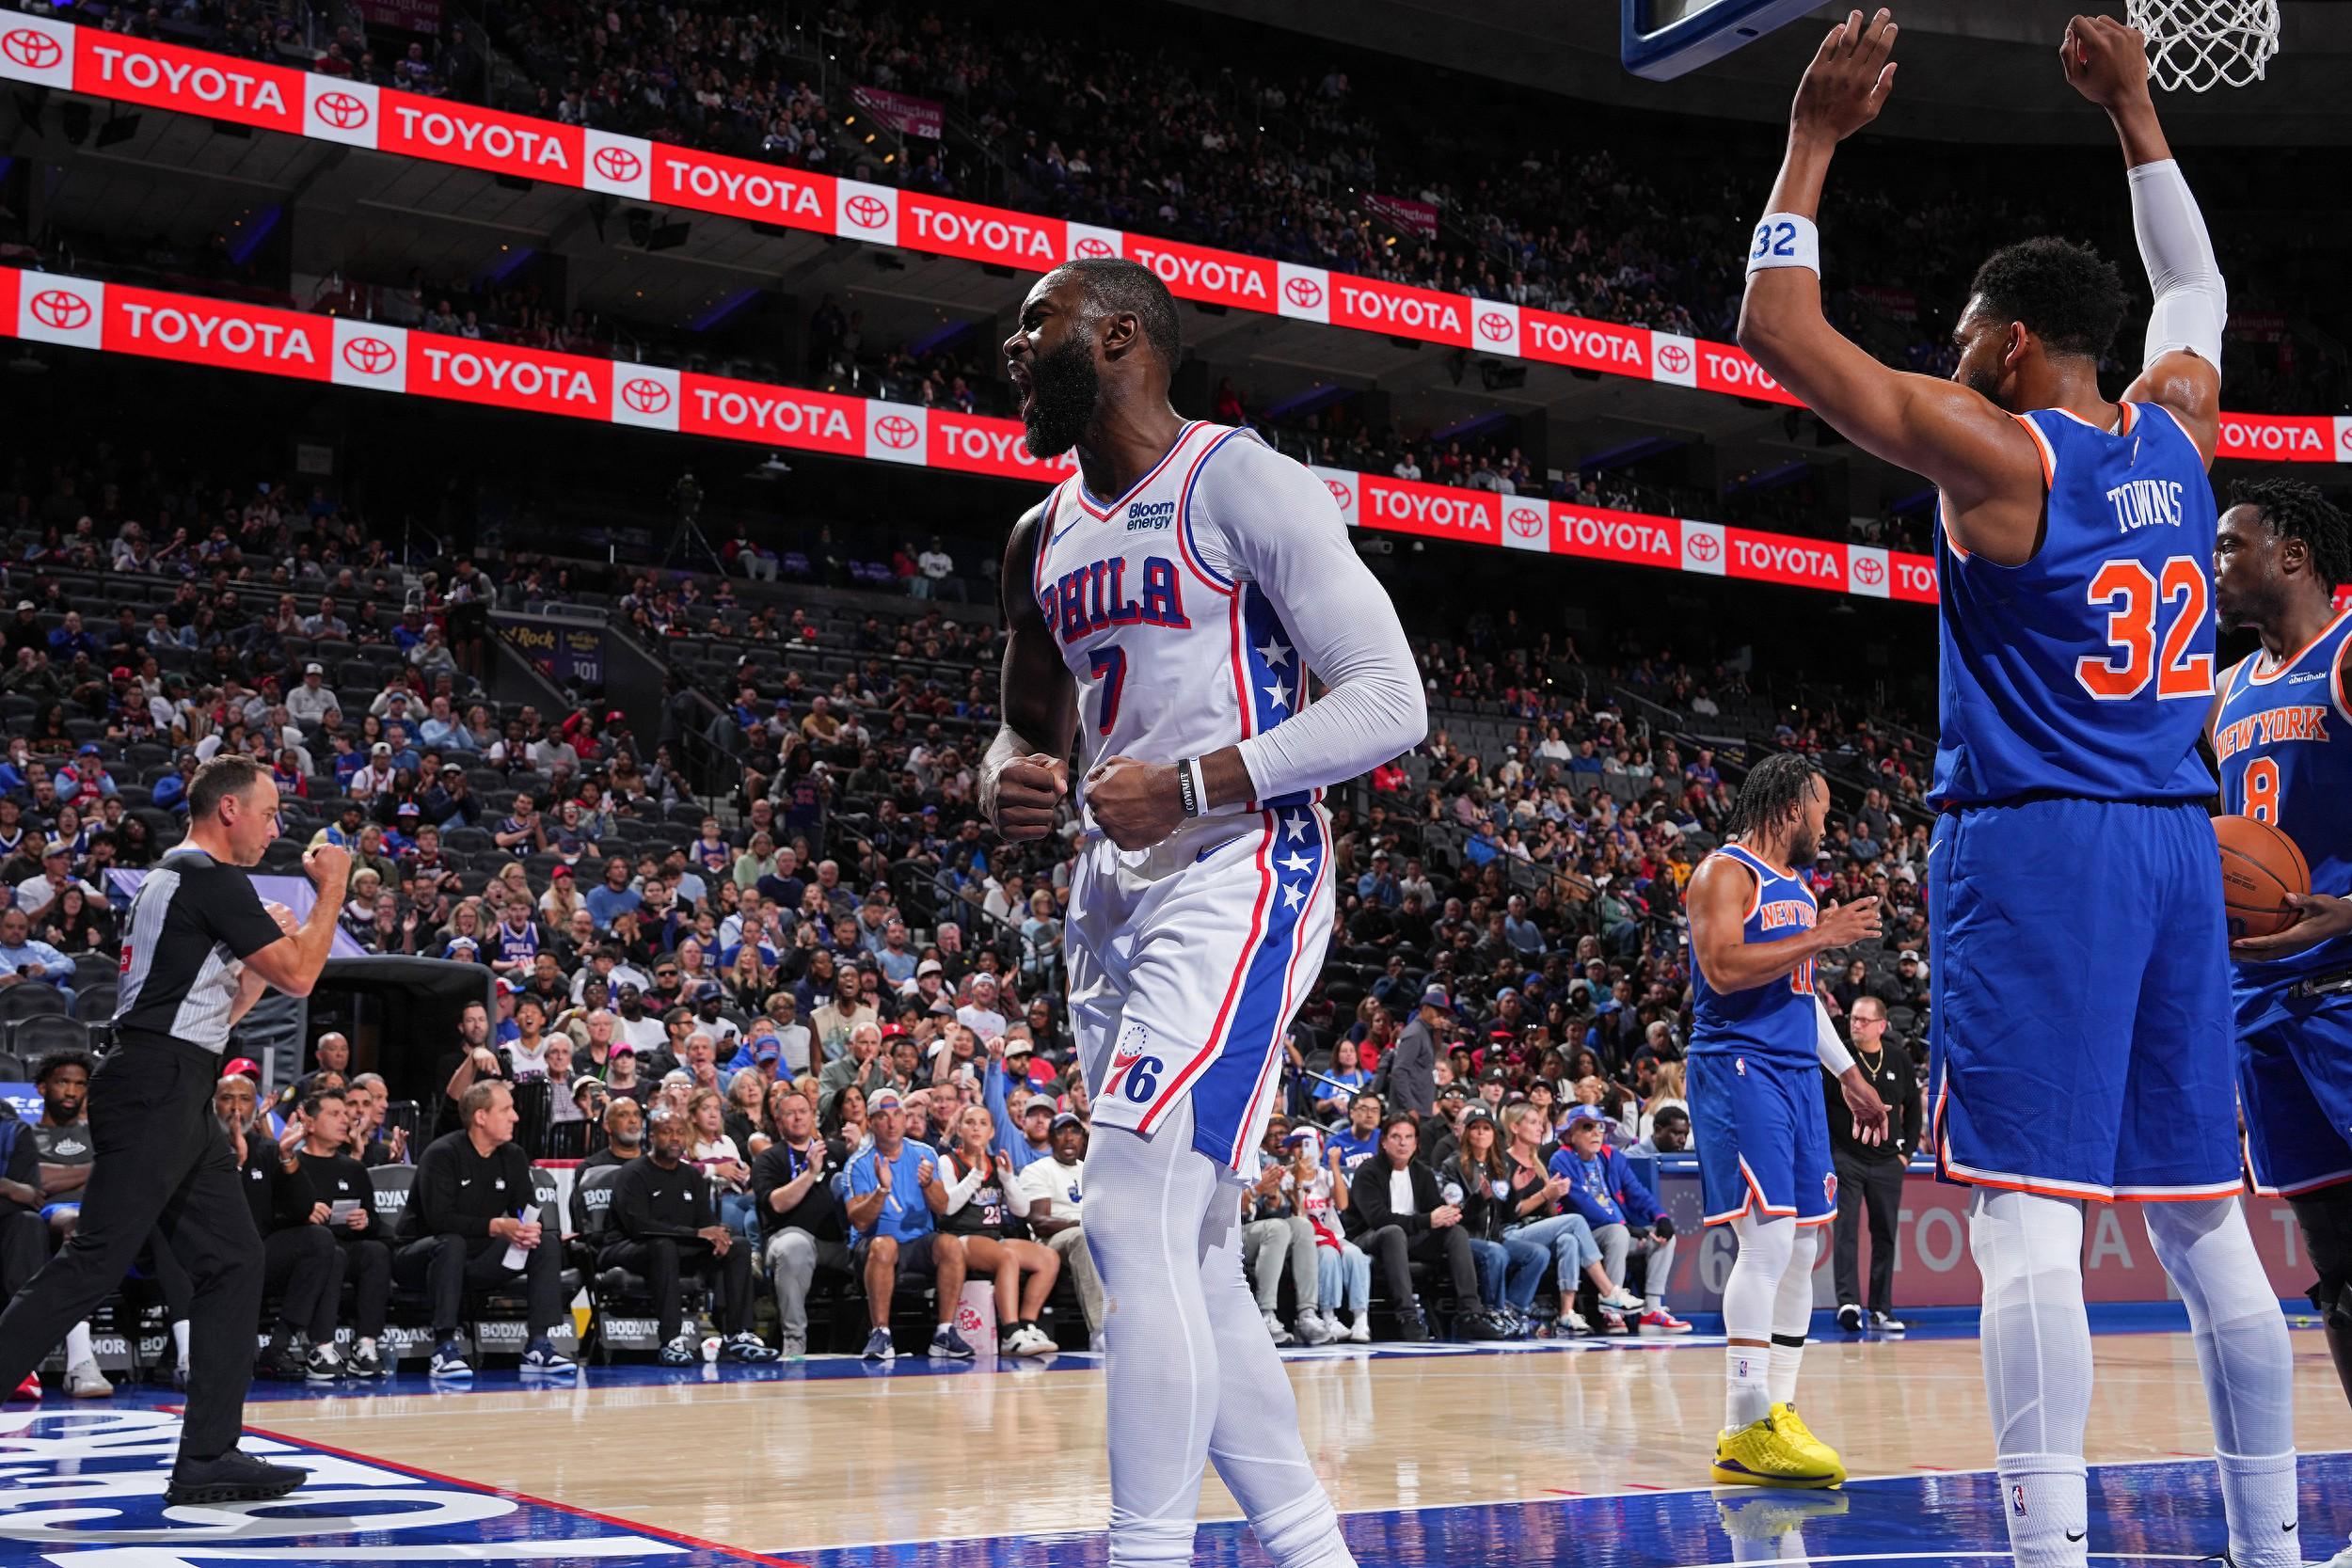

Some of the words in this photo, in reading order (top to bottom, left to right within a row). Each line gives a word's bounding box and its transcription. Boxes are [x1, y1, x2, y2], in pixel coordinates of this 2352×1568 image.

[93, 46, 286, 115] TOYOTA
[396, 106, 568, 169] TOYOTA
[666, 160, 822, 217] TOYOTA
[911, 207, 1054, 260] TOYOTA
[1753, 222, 1796, 260] 32
[1135, 248, 1266, 298] TOYOTA
[122, 303, 314, 363] TOYOTA
[1340, 287, 1461, 334] TOYOTA
[1529, 321, 1643, 365] TOYOTA
[423, 348, 596, 404] TOYOTA
[1705, 354, 1786, 391] TOYO
[694, 388, 851, 440] TOYOTA
[2219, 422, 2323, 450] OYOTA
[1127, 515, 1173, 531] energy
[1129, 501, 1175, 519] Bloom
[1370, 488, 1491, 531] TOYOTA
[2106, 479, 2183, 534] TOWNS
[1559, 515, 1672, 555] TOYOTA
[1734, 540, 1839, 578] TOYOTA
[1041, 556, 1192, 644] PHILA
[518, 627, 556, 649] Rock
[2074, 555, 2216, 701] 32
[572, 660, 597, 681] 101
[1088, 644, 1127, 736] 7
[2216, 714, 2258, 770] NEW
[2258, 705, 2331, 746] YORK
[2243, 755, 2280, 828] 8
[1760, 900, 1799, 931] NEW
[1103, 1053, 1164, 1104] 76
